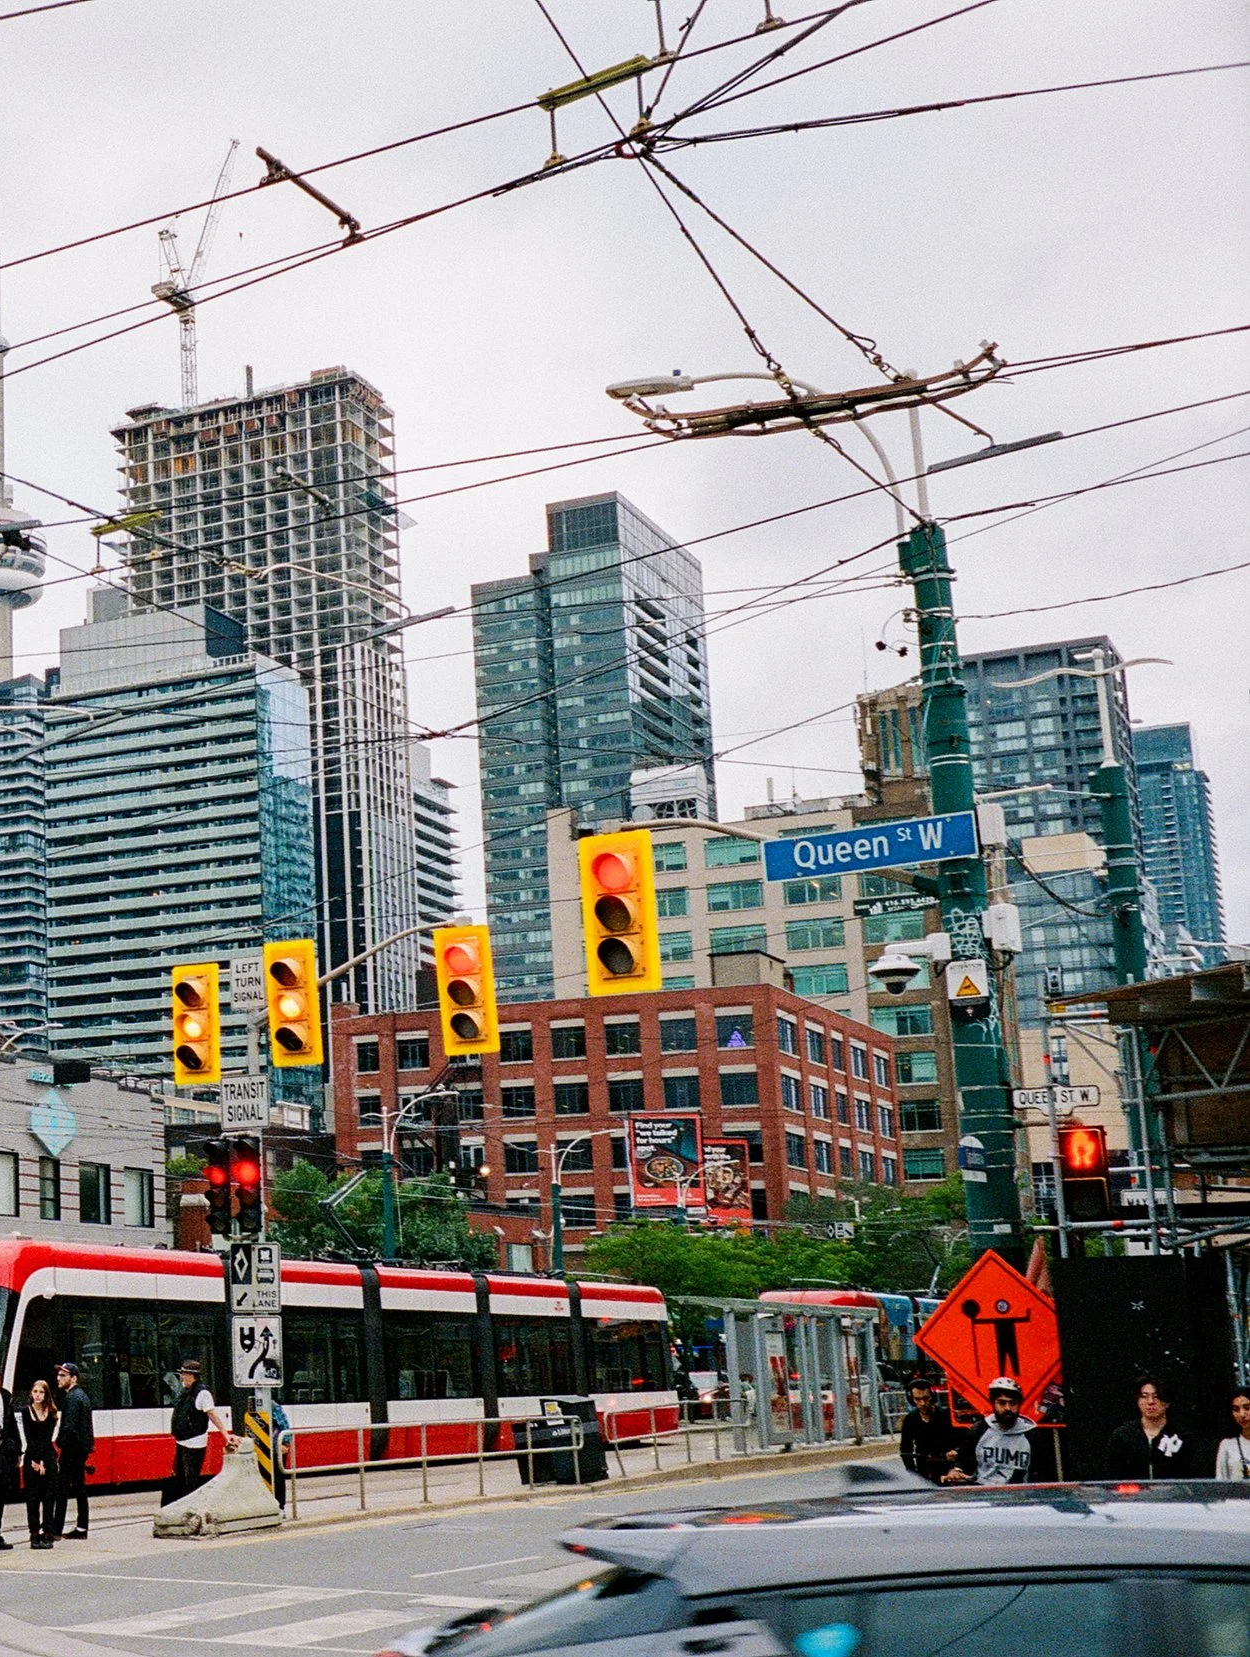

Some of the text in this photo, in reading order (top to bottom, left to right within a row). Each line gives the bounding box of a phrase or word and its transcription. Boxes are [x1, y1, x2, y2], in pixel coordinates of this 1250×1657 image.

[793, 821, 943, 870] Queen St W
[235, 962, 260, 974] LEFT
[234, 977, 262, 988] TURN
[233, 990, 264, 1003] SIGNAL
[223, 1081, 265, 1101] TRANSIT
[1019, 1090, 1057, 1105] QUEE
[227, 1105, 264, 1122] SIGNAL
[635, 1121, 653, 1129] Find
[256, 1290, 278, 1299] THIS
[253, 1299, 277, 1308] LANE
